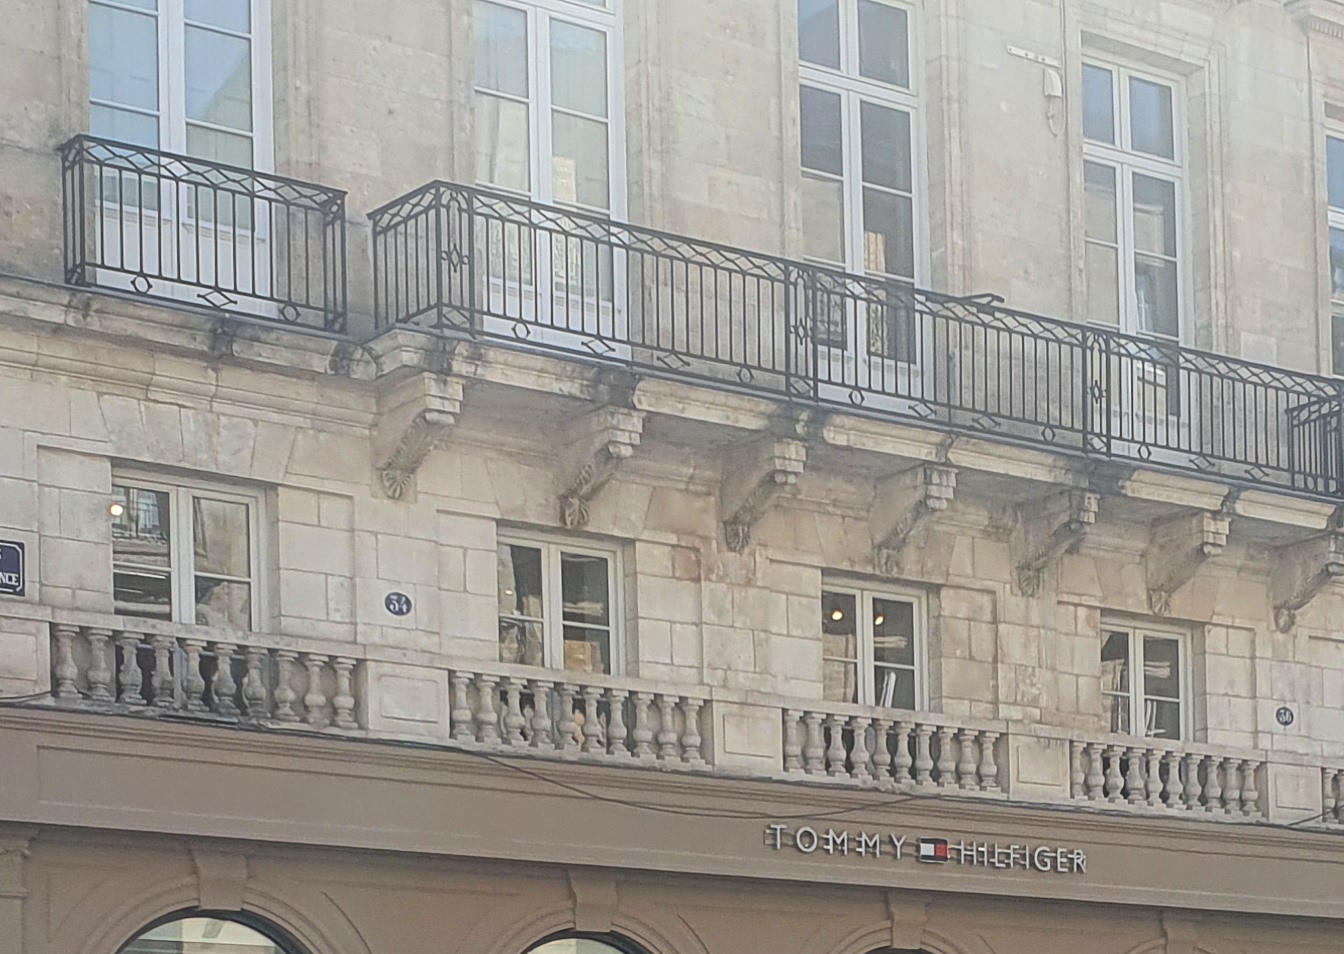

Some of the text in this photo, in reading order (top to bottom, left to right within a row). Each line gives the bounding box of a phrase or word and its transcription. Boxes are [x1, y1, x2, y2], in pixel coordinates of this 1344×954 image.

[389, 594, 408, 613] 34
[766, 823, 1087, 874] TOMMY HILFIGER
